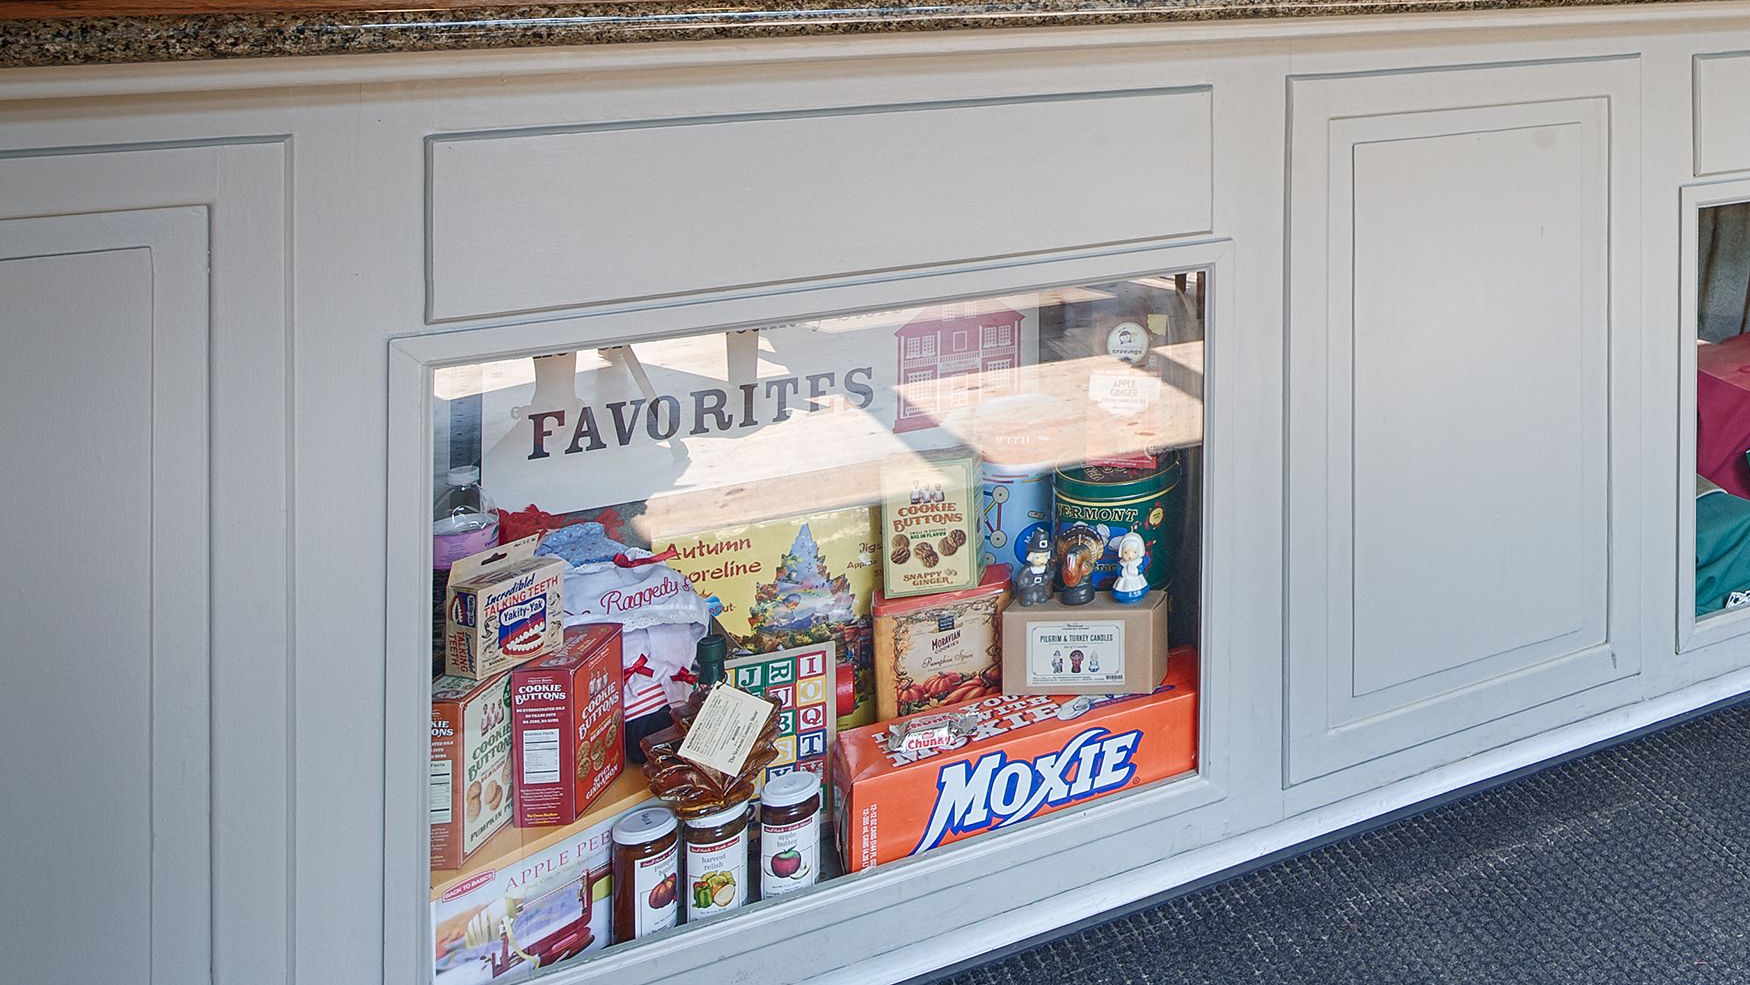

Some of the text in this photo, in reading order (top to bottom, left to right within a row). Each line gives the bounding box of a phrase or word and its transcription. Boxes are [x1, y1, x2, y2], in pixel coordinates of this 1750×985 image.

[527, 367, 875, 461] FAVORITES
[897, 503, 957, 517] COOKIE
[893, 513, 963, 533] BUTTONS
[665, 536, 752, 561] Autumn
[674, 559, 762, 584] oreline
[903, 570, 942, 582] SNAPPY
[912, 576, 954, 587] GINGER
[484, 590, 527, 618] TALKING
[528, 575, 559, 596] TEETH
[600, 576, 679, 615] Raggedy
[502, 599, 544, 623] Yakity-Yak
[931, 630, 961, 651] MORAVIAN
[1040, 635, 1062, 643] PILGRIM
[1069, 634, 1089, 642] TURKEY
[1090, 633, 1113, 642] CANDLES
[741, 657, 816, 687] J R I
[515, 692, 567, 705] BUTTONS
[518, 684, 562, 693] COOKIE
[582, 681, 616, 719] COOKIE
[578, 691, 620, 740] BUTTONS
[802, 708, 822, 726] Q
[802, 735, 820, 754] T
[907, 733, 952, 751] Chunky
[468, 737, 512, 783] BUTTON
[913, 730, 1141, 856] MOXIE
[470, 811, 502, 842] PUMPKIN
[778, 832, 797, 841] apple
[777, 838, 798, 848] butter
[504, 850, 569, 893] APPLE
[577, 830, 612, 858] PEE
[701, 853, 726, 864] harvest
[704, 862, 724, 872] relish
[445, 872, 495, 899] BACK TO BASICS
